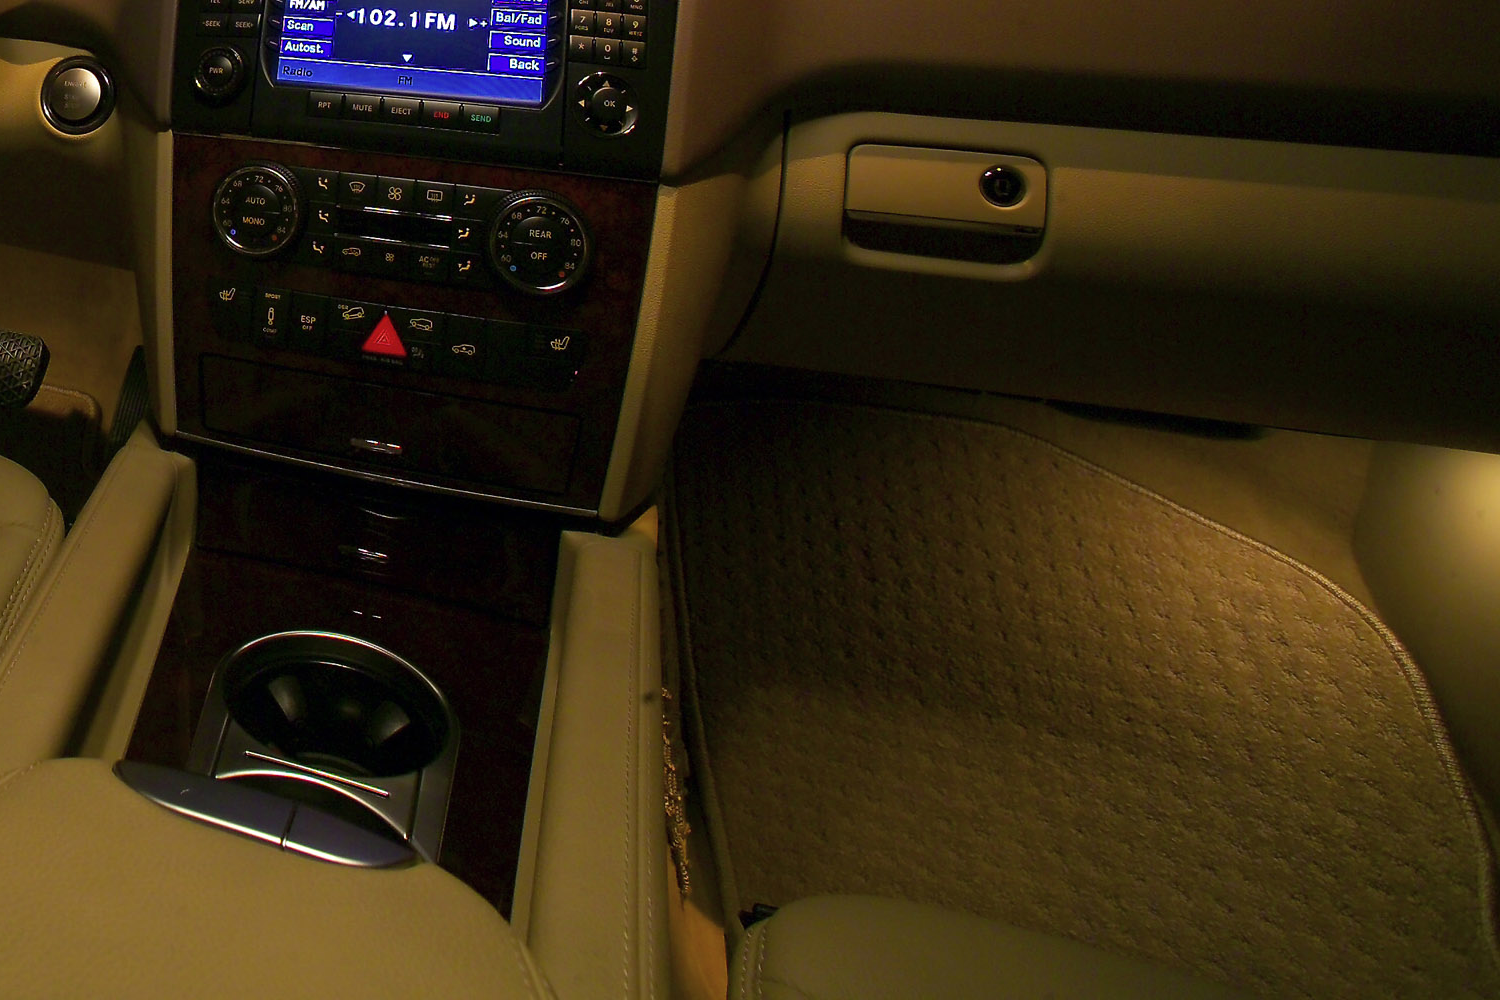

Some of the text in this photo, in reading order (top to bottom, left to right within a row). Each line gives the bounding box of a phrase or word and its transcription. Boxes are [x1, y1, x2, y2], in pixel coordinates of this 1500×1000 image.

[357, 6, 456, 31] 102.1 FM
[495, 11, 543, 27] Bal/Fad
[579, 15, 586, 24] 7
[605, 18, 612, 26] 8
[286, 19, 314, 32] Scan
[632, 20, 639, 29] 9
[503, 34, 542, 48] Sound
[284, 41, 325, 55] Autost.
[604, 44, 611, 52] 0
[509, 57, 540, 72] Back
[208, 67, 224, 75] PWR
[281, 65, 313, 78] Radio
[397, 75, 413, 86] FM
[317, 101, 332, 109] RPT
[352, 103, 373, 112] MUTE
[603, 100, 616, 108] OK
[391, 106, 412, 115] EJECT
[432, 109, 450, 119] END
[470, 113, 492, 123] SEND
[254, 175, 264, 183] 72
[274, 184, 284, 193] 76
[220, 197, 230, 205] 64
[245, 196, 266, 205] AUTO
[536, 205, 547, 215] 72
[511, 212, 522, 220] 68
[560, 216, 570, 225] 76
[242, 216, 265, 226] MONO
[498, 230, 508, 239] 64
[529, 229, 552, 239] REAR
[500, 254, 512, 263] 60
[530, 251, 548, 261] OFF
[300, 314, 317, 325] ESP
